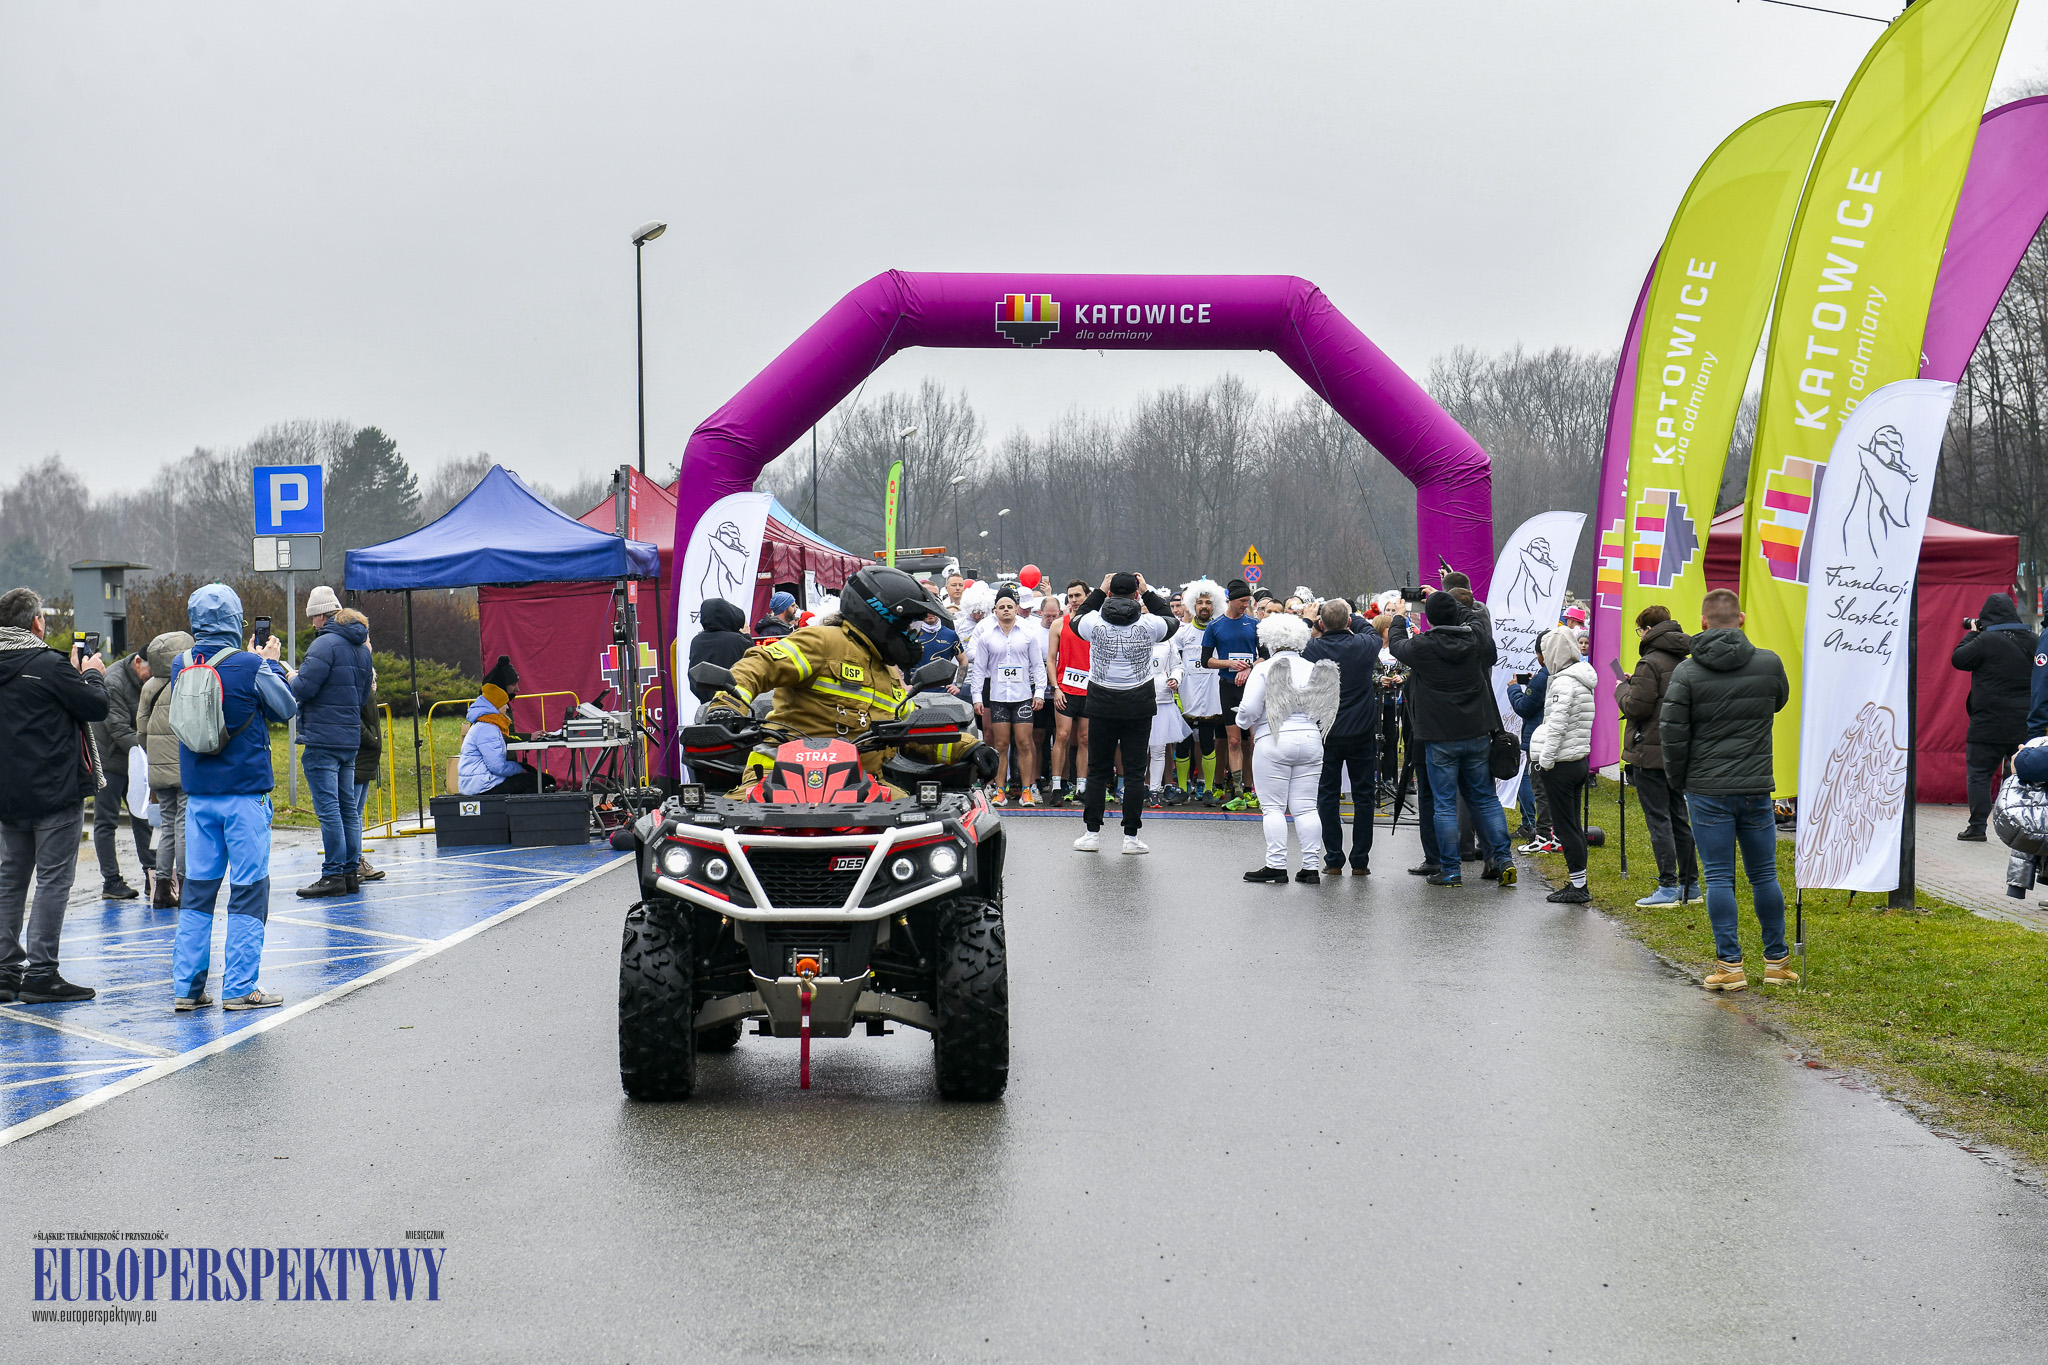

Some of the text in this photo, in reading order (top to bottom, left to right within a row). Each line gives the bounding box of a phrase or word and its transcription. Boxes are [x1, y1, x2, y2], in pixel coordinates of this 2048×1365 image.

[1075, 303, 1212, 325] KATOWICE
[1794, 167, 1882, 431] KATOWICE
[1075, 329, 1153, 342] dla odmiany
[1848, 286, 1888, 391] odmiany
[1652, 258, 1717, 465] KATOWICE
[1682, 350, 1719, 432] odmiany
[269, 473, 309, 527] P
[1826, 595, 1901, 628] Śląskie
[1823, 628, 1893, 666] Anioły
[844, 666, 861, 679] OSP
[1004, 668, 1017, 677] 64
[1067, 673, 1087, 683] 107
[831, 859, 864, 870] ODES
